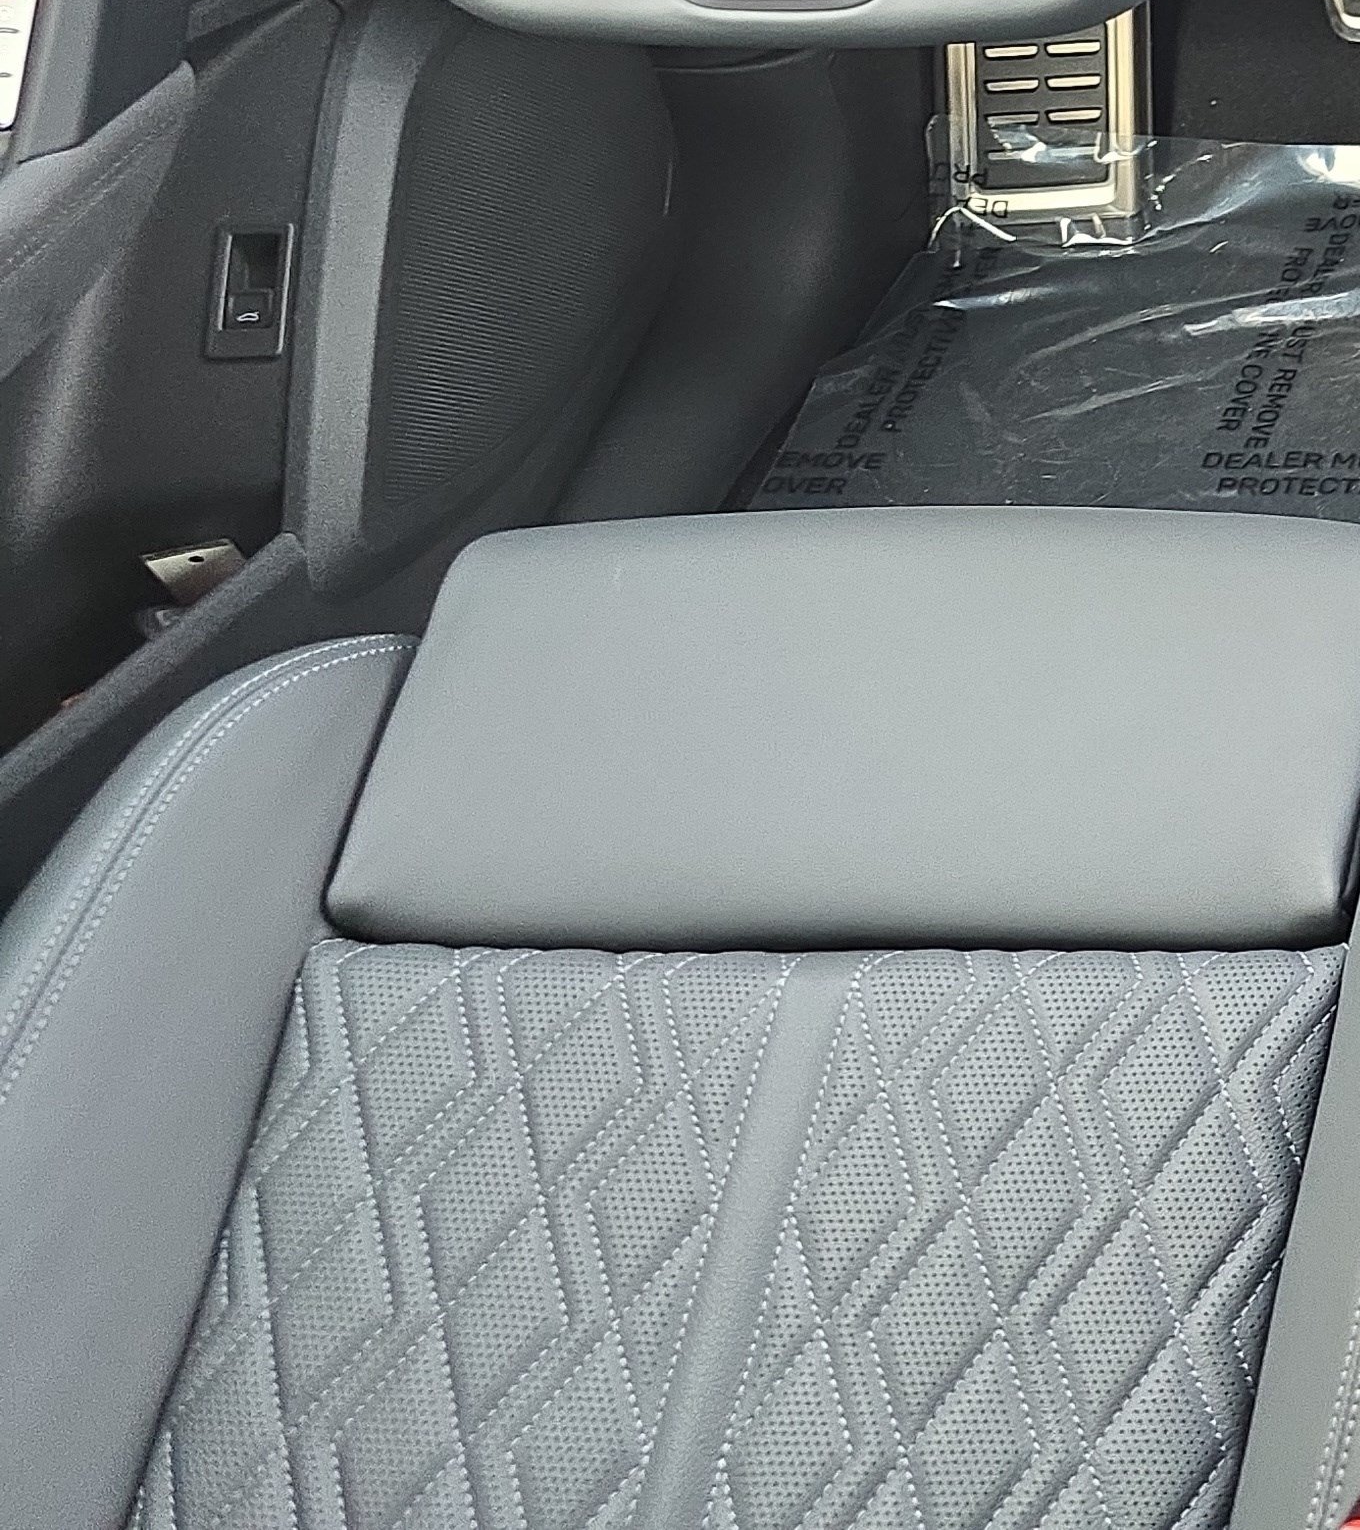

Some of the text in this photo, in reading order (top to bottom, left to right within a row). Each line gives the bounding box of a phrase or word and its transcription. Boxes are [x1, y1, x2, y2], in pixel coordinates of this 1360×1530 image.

[1215, 362, 1264, 433] COVER
[1243, 367, 1298, 450] REMOVE
[1200, 450, 1326, 472] DEALER
